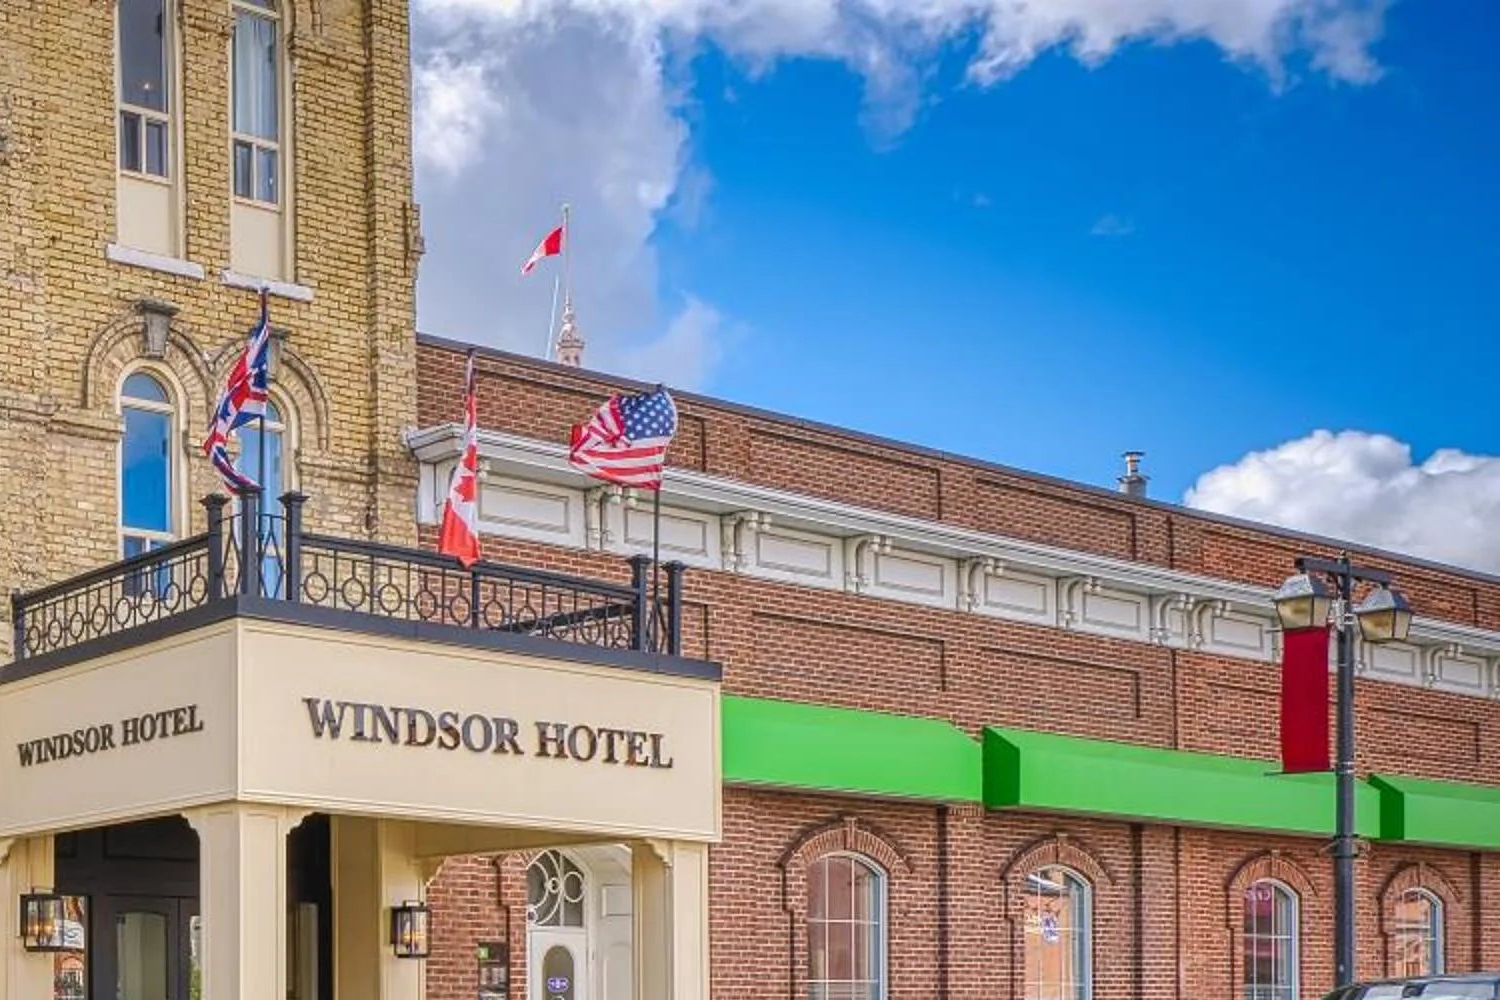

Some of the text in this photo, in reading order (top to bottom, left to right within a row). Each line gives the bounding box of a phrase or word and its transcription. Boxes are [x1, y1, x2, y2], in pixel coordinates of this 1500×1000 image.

[18, 704, 203, 768] WINDSOR HOTEL
[301, 698, 673, 769] WINDSOR HOTEL
